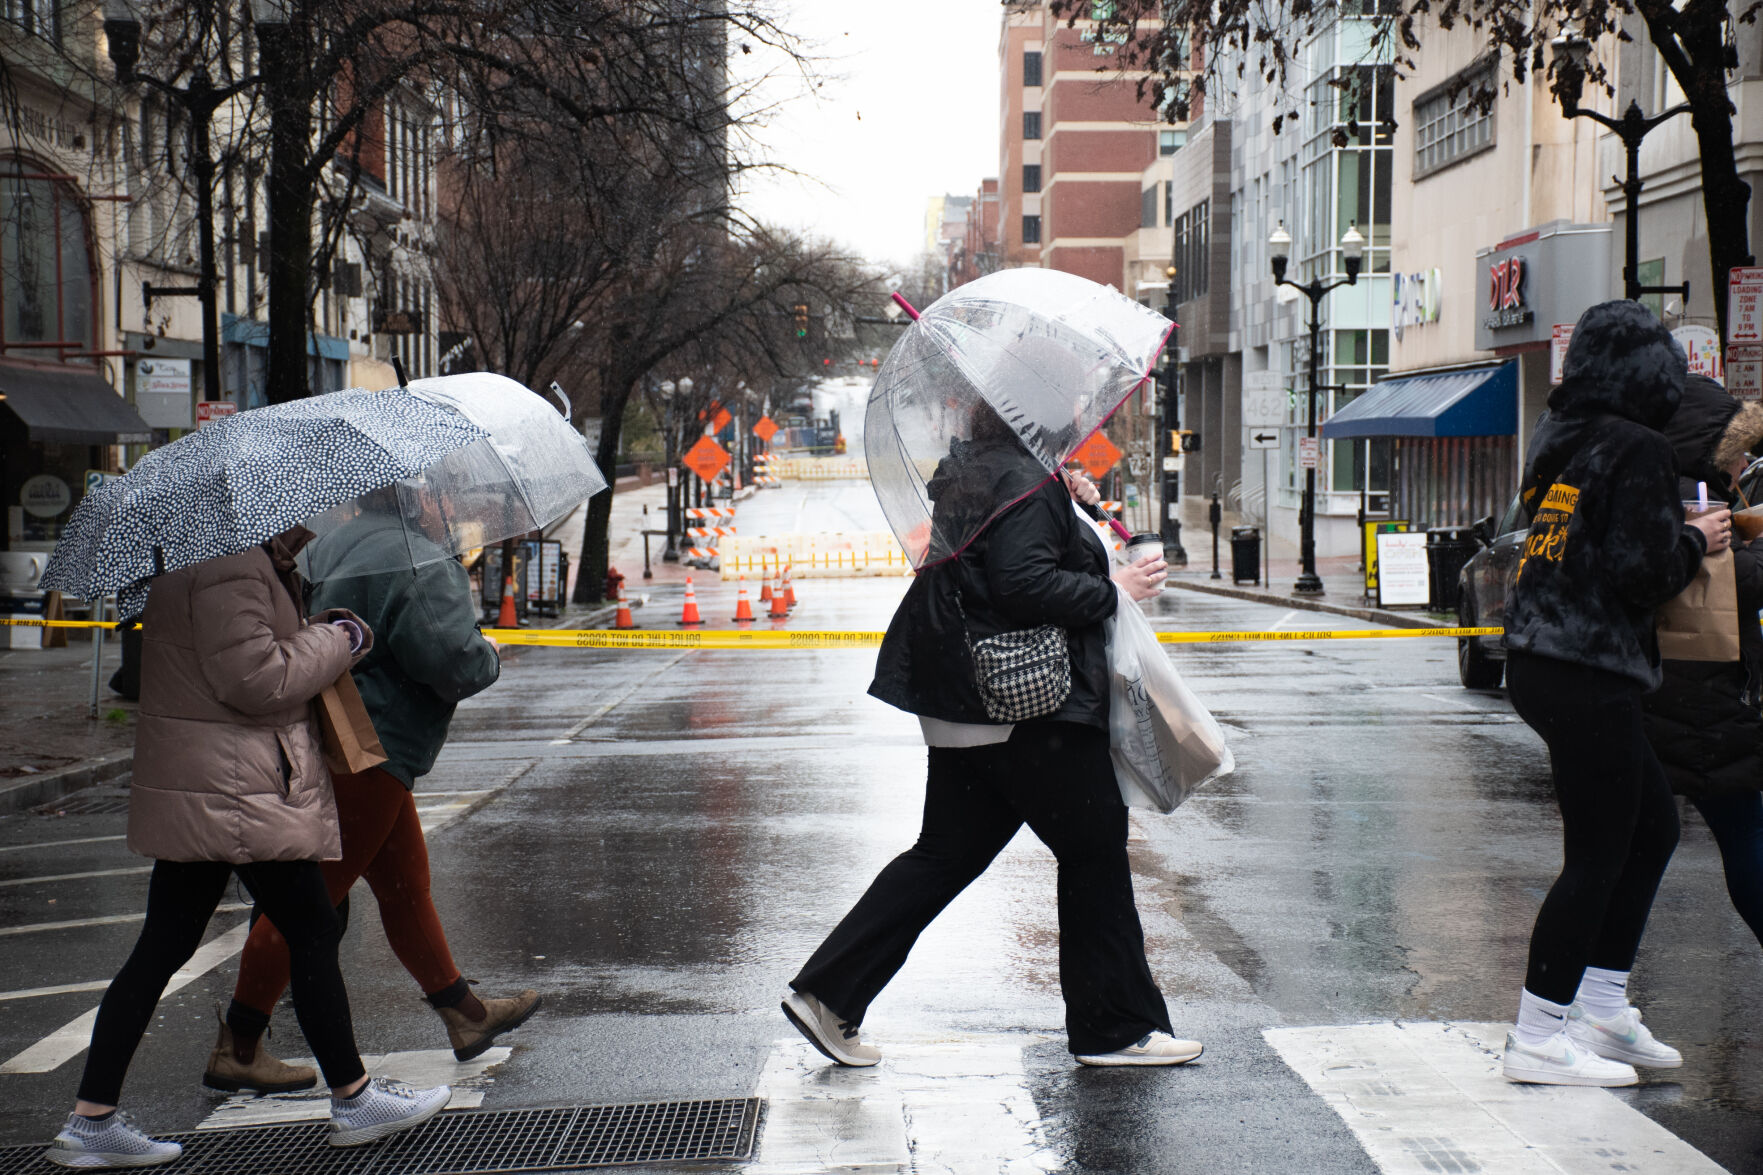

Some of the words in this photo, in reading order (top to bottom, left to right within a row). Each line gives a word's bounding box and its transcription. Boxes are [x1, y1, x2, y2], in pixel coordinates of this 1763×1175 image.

[1489, 256, 1520, 312] DTLR
[1732, 286, 1762, 294] LOADING
[1739, 295, 1756, 303] ZONE
[1744, 304, 1755, 312] AM
[1742, 313, 1751, 321] TO
[1743, 323, 1755, 331] PM
[1728, 348, 1738, 361] NO
[1744, 364, 1755, 372] AM
[1252, 374, 1277, 385] WEST
[1728, 388, 1761, 396] WEEKDAYS
[198, 405, 209, 418] NO
[1247, 398, 1282, 417] 462
[88, 473, 103, 491] 2
[1546, 489, 1578, 507] OMING
